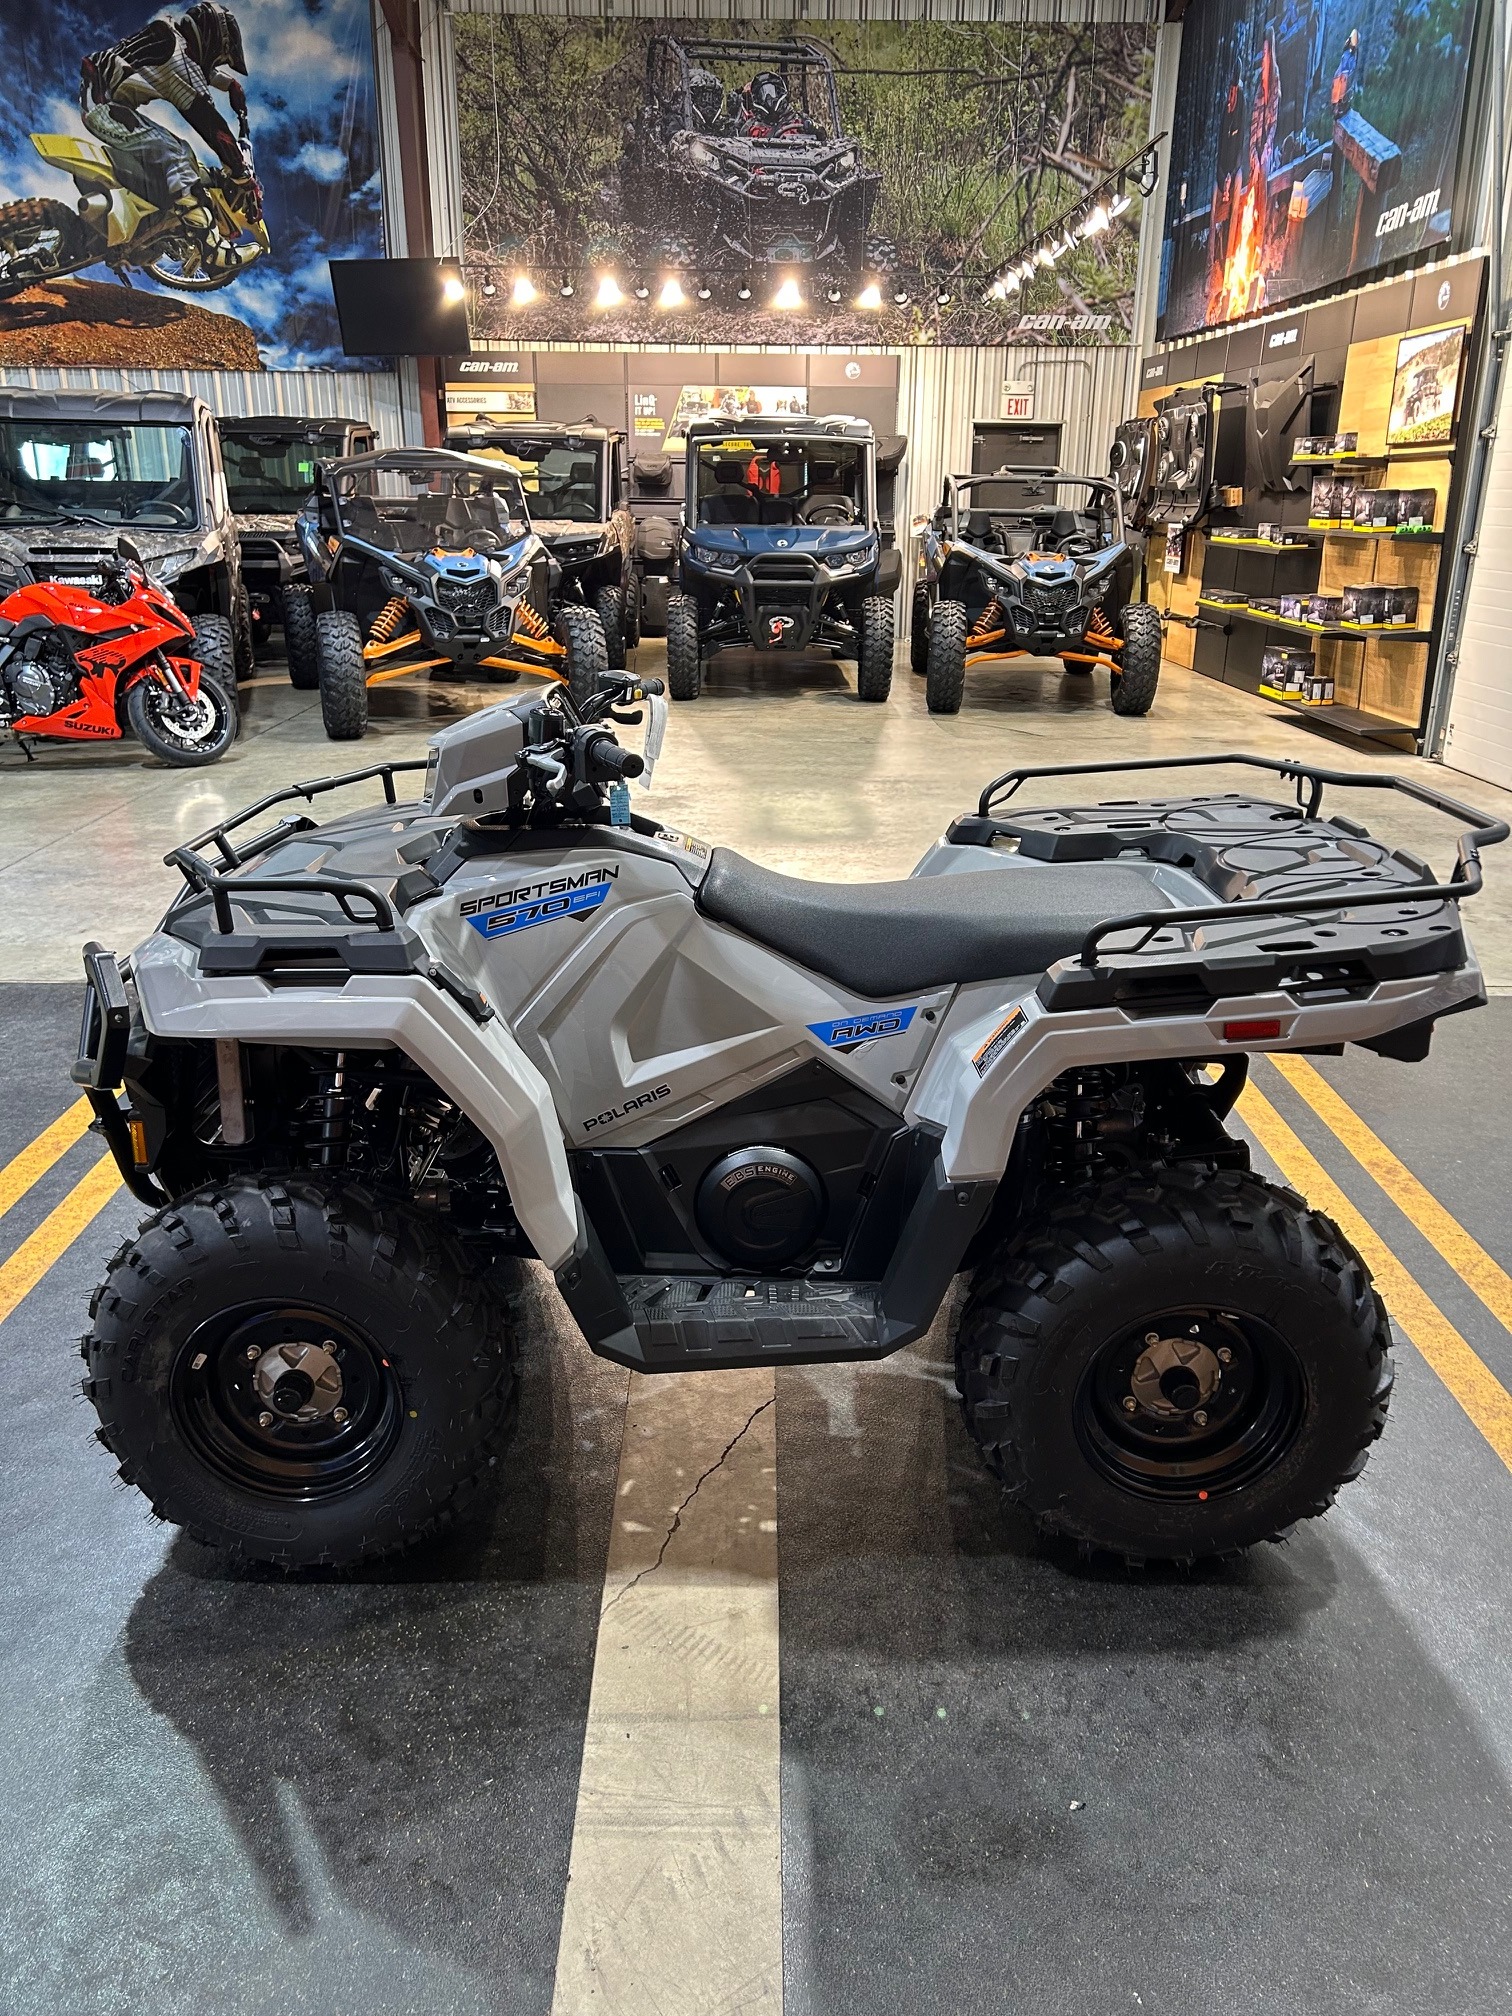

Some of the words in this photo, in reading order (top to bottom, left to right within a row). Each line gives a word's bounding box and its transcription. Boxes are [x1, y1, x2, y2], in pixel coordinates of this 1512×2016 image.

[1375, 188, 1441, 238] can-am
[1018, 314, 1112, 330] can-am
[459, 361, 518, 373] can-am
[1007, 398, 1029, 416] EXIT
[49, 574, 103, 586] Kawasaki
[64, 720, 115, 736] SUZUKI
[459, 864, 620, 917] SPORTSMAN
[486, 896, 571, 932] 570
[573, 890, 602, 904] EFI
[832, 1020, 849, 1028] ON
[853, 1011, 903, 1024] DEMAND
[831, 1017, 902, 1041] AWD
[582, 1083, 672, 1132] POLARIS
[756, 1165, 796, 1182] ENGINE
